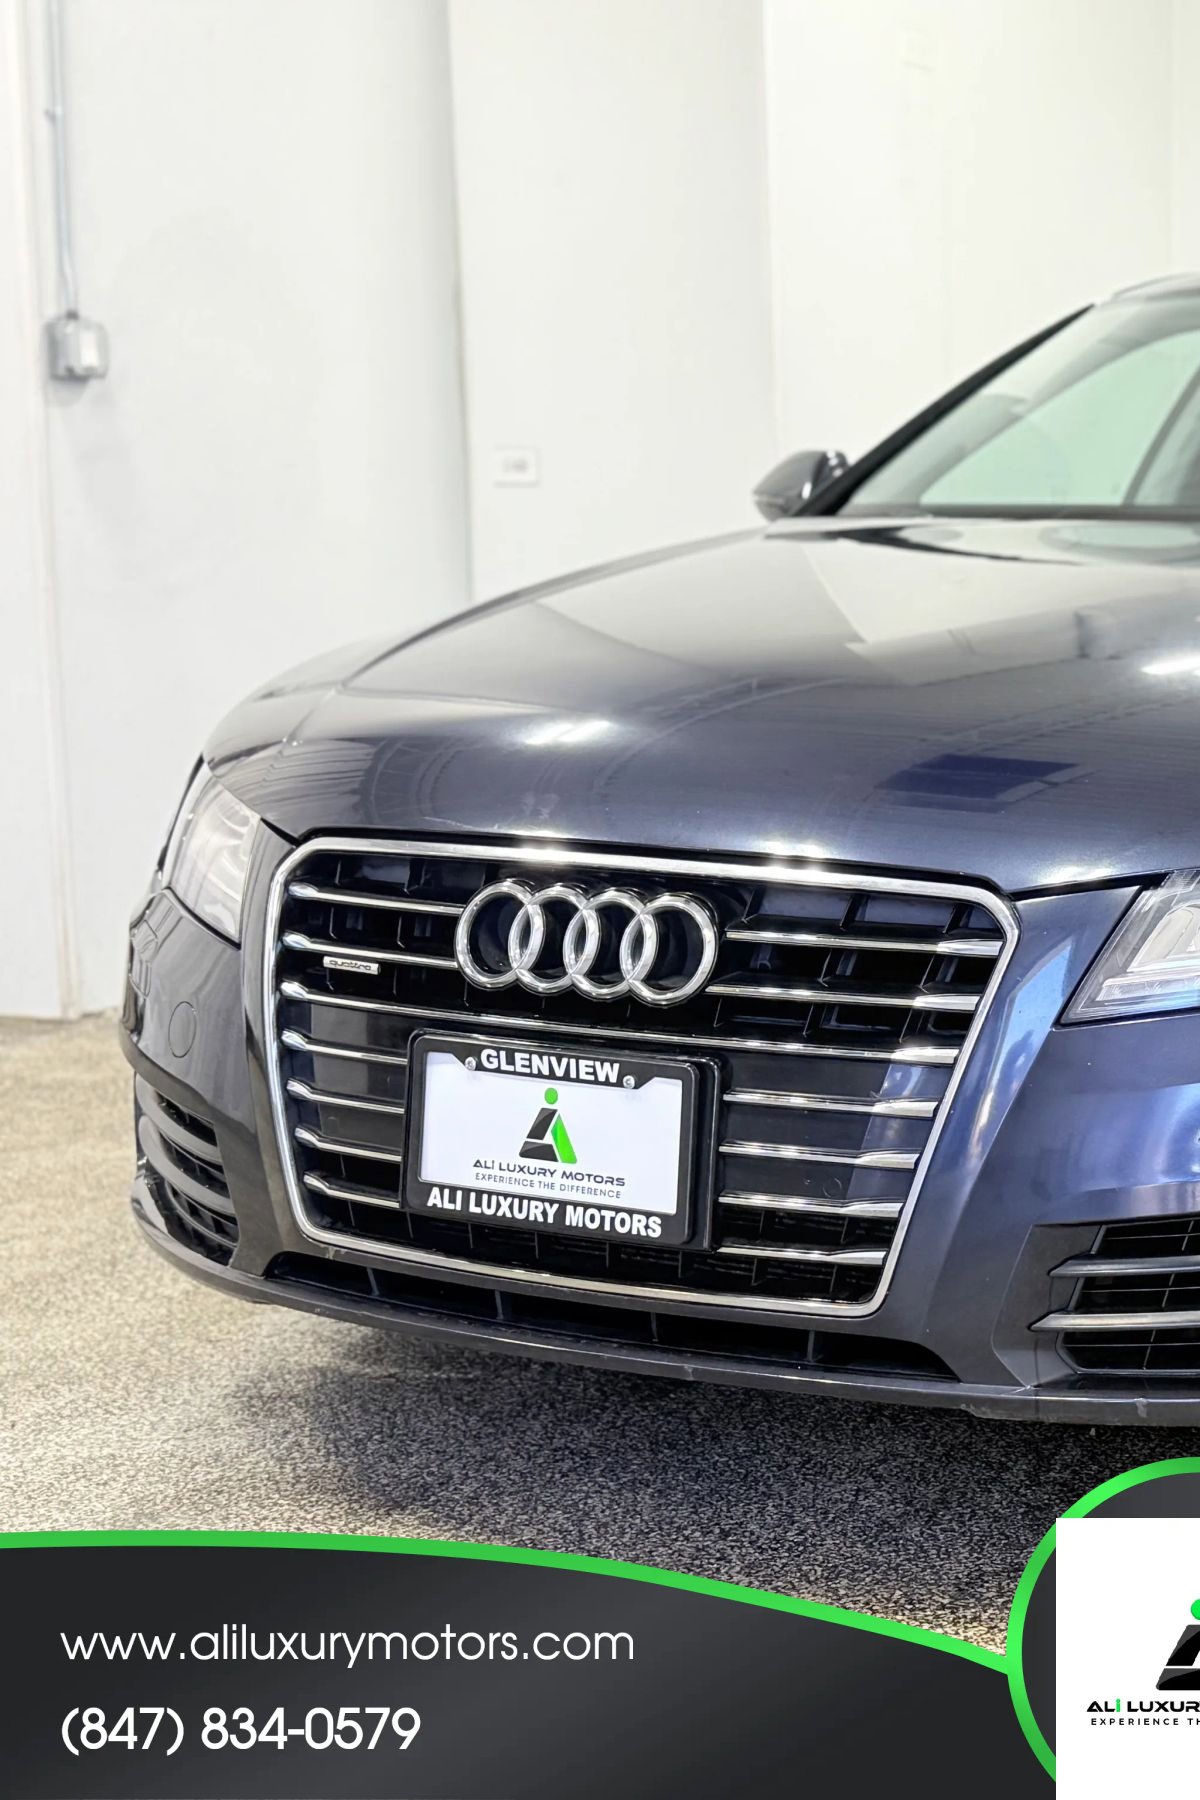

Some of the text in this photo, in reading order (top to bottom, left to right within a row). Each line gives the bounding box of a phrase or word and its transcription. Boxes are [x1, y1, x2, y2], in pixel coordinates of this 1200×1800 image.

[329, 959, 372, 971] quattro
[480, 1048, 620, 1084] GLENVIEW
[475, 1172, 622, 1199] EXPERIENCE THE DIFFERENCE
[498, 1161, 557, 1178] LUXURY
[560, 1170, 626, 1188] MOTORS
[426, 1186, 662, 1239] ALI LUXURY MOTORS
